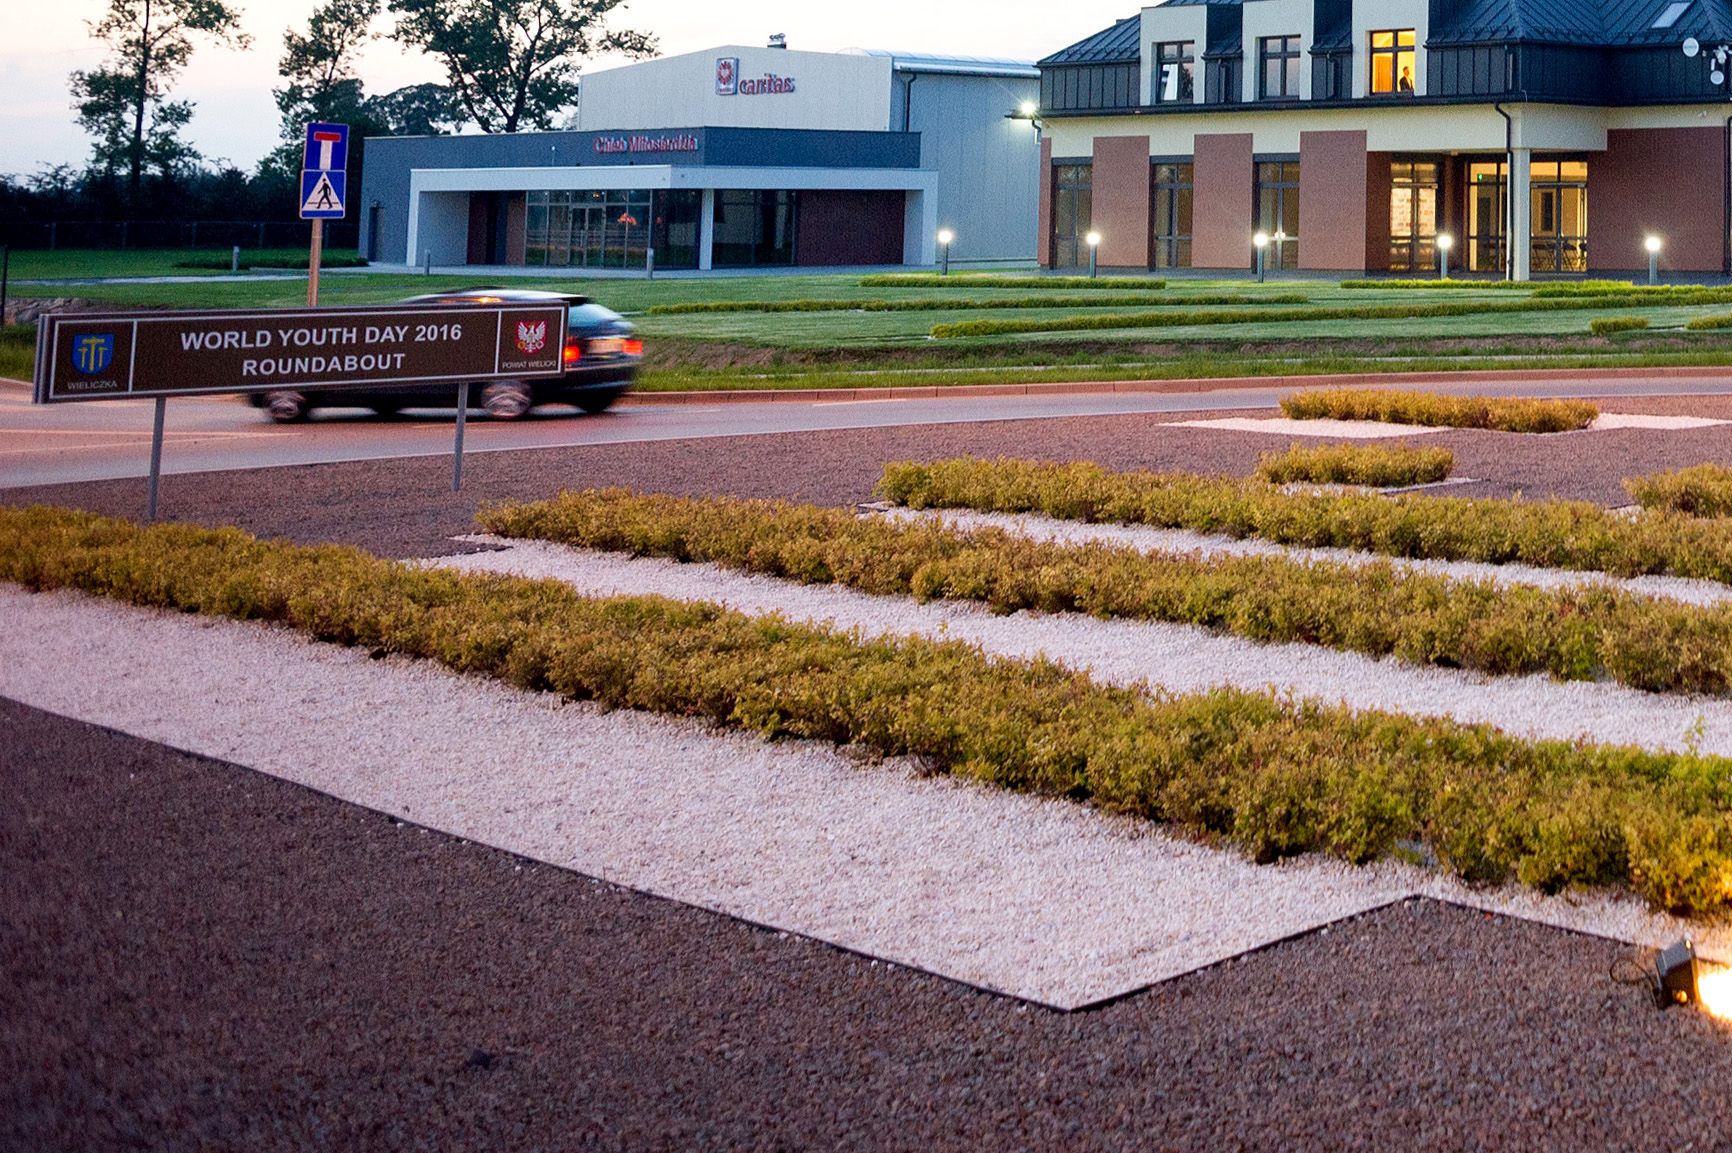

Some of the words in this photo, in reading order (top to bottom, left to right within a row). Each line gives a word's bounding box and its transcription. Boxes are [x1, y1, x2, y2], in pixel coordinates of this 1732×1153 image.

[739, 72, 796, 95] caritas
[181, 330, 271, 351] WORLD
[278, 326, 357, 347] YOUTH
[364, 325, 409, 344] DAY
[414, 323, 462, 342] 2016
[242, 352, 405, 376] ROUNDABOUT
[502, 361, 527, 369] POWIAT
[67, 380, 118, 391] WIELICZKA
